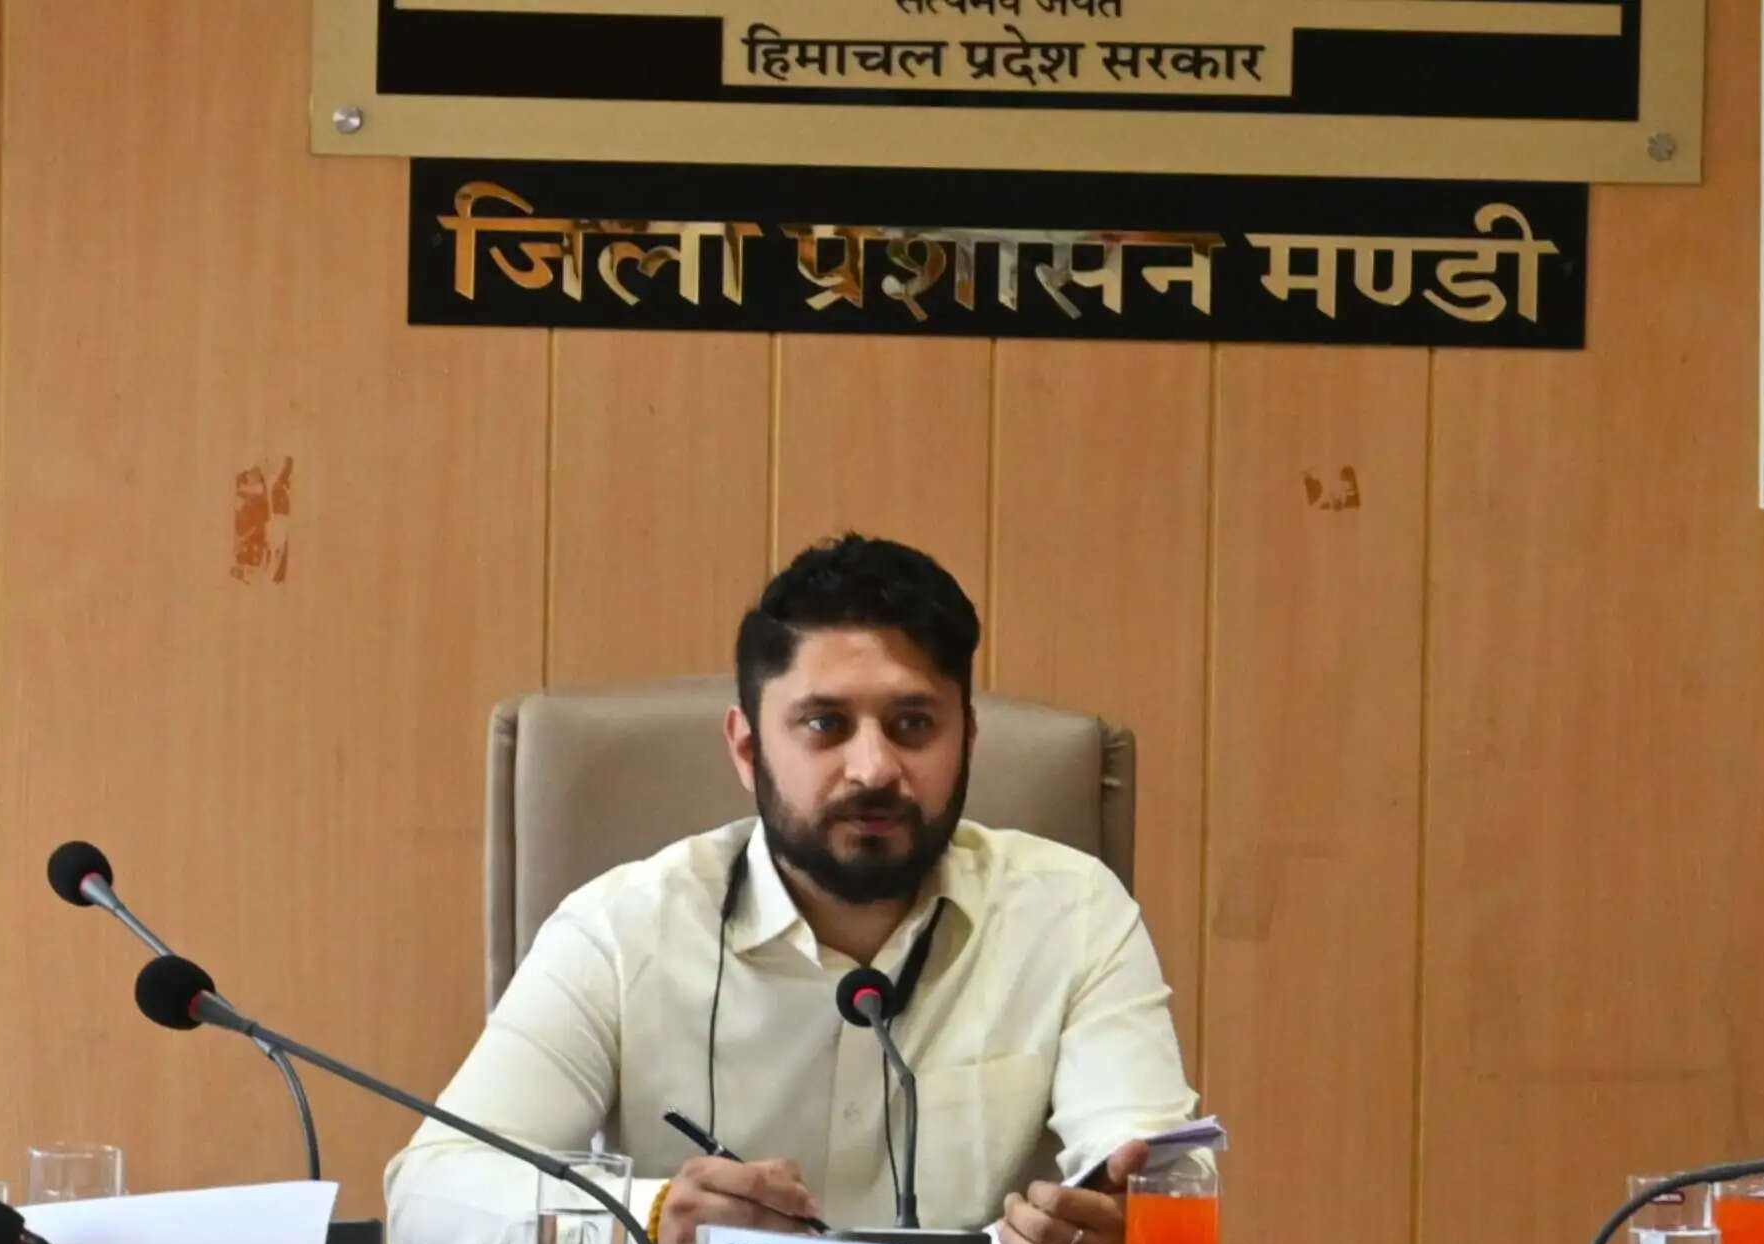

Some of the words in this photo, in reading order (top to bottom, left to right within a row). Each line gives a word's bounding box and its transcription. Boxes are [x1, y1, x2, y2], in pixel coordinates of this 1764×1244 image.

[741, 23, 946, 81] हिमाचल
[960, 25, 1085, 84] प्रदेश
[1096, 42, 1265, 81] सरकार
[437, 181, 764, 306] जिला
[780, 222, 1227, 322] प्रशासन
[1244, 202, 1560, 323] मण्डी
